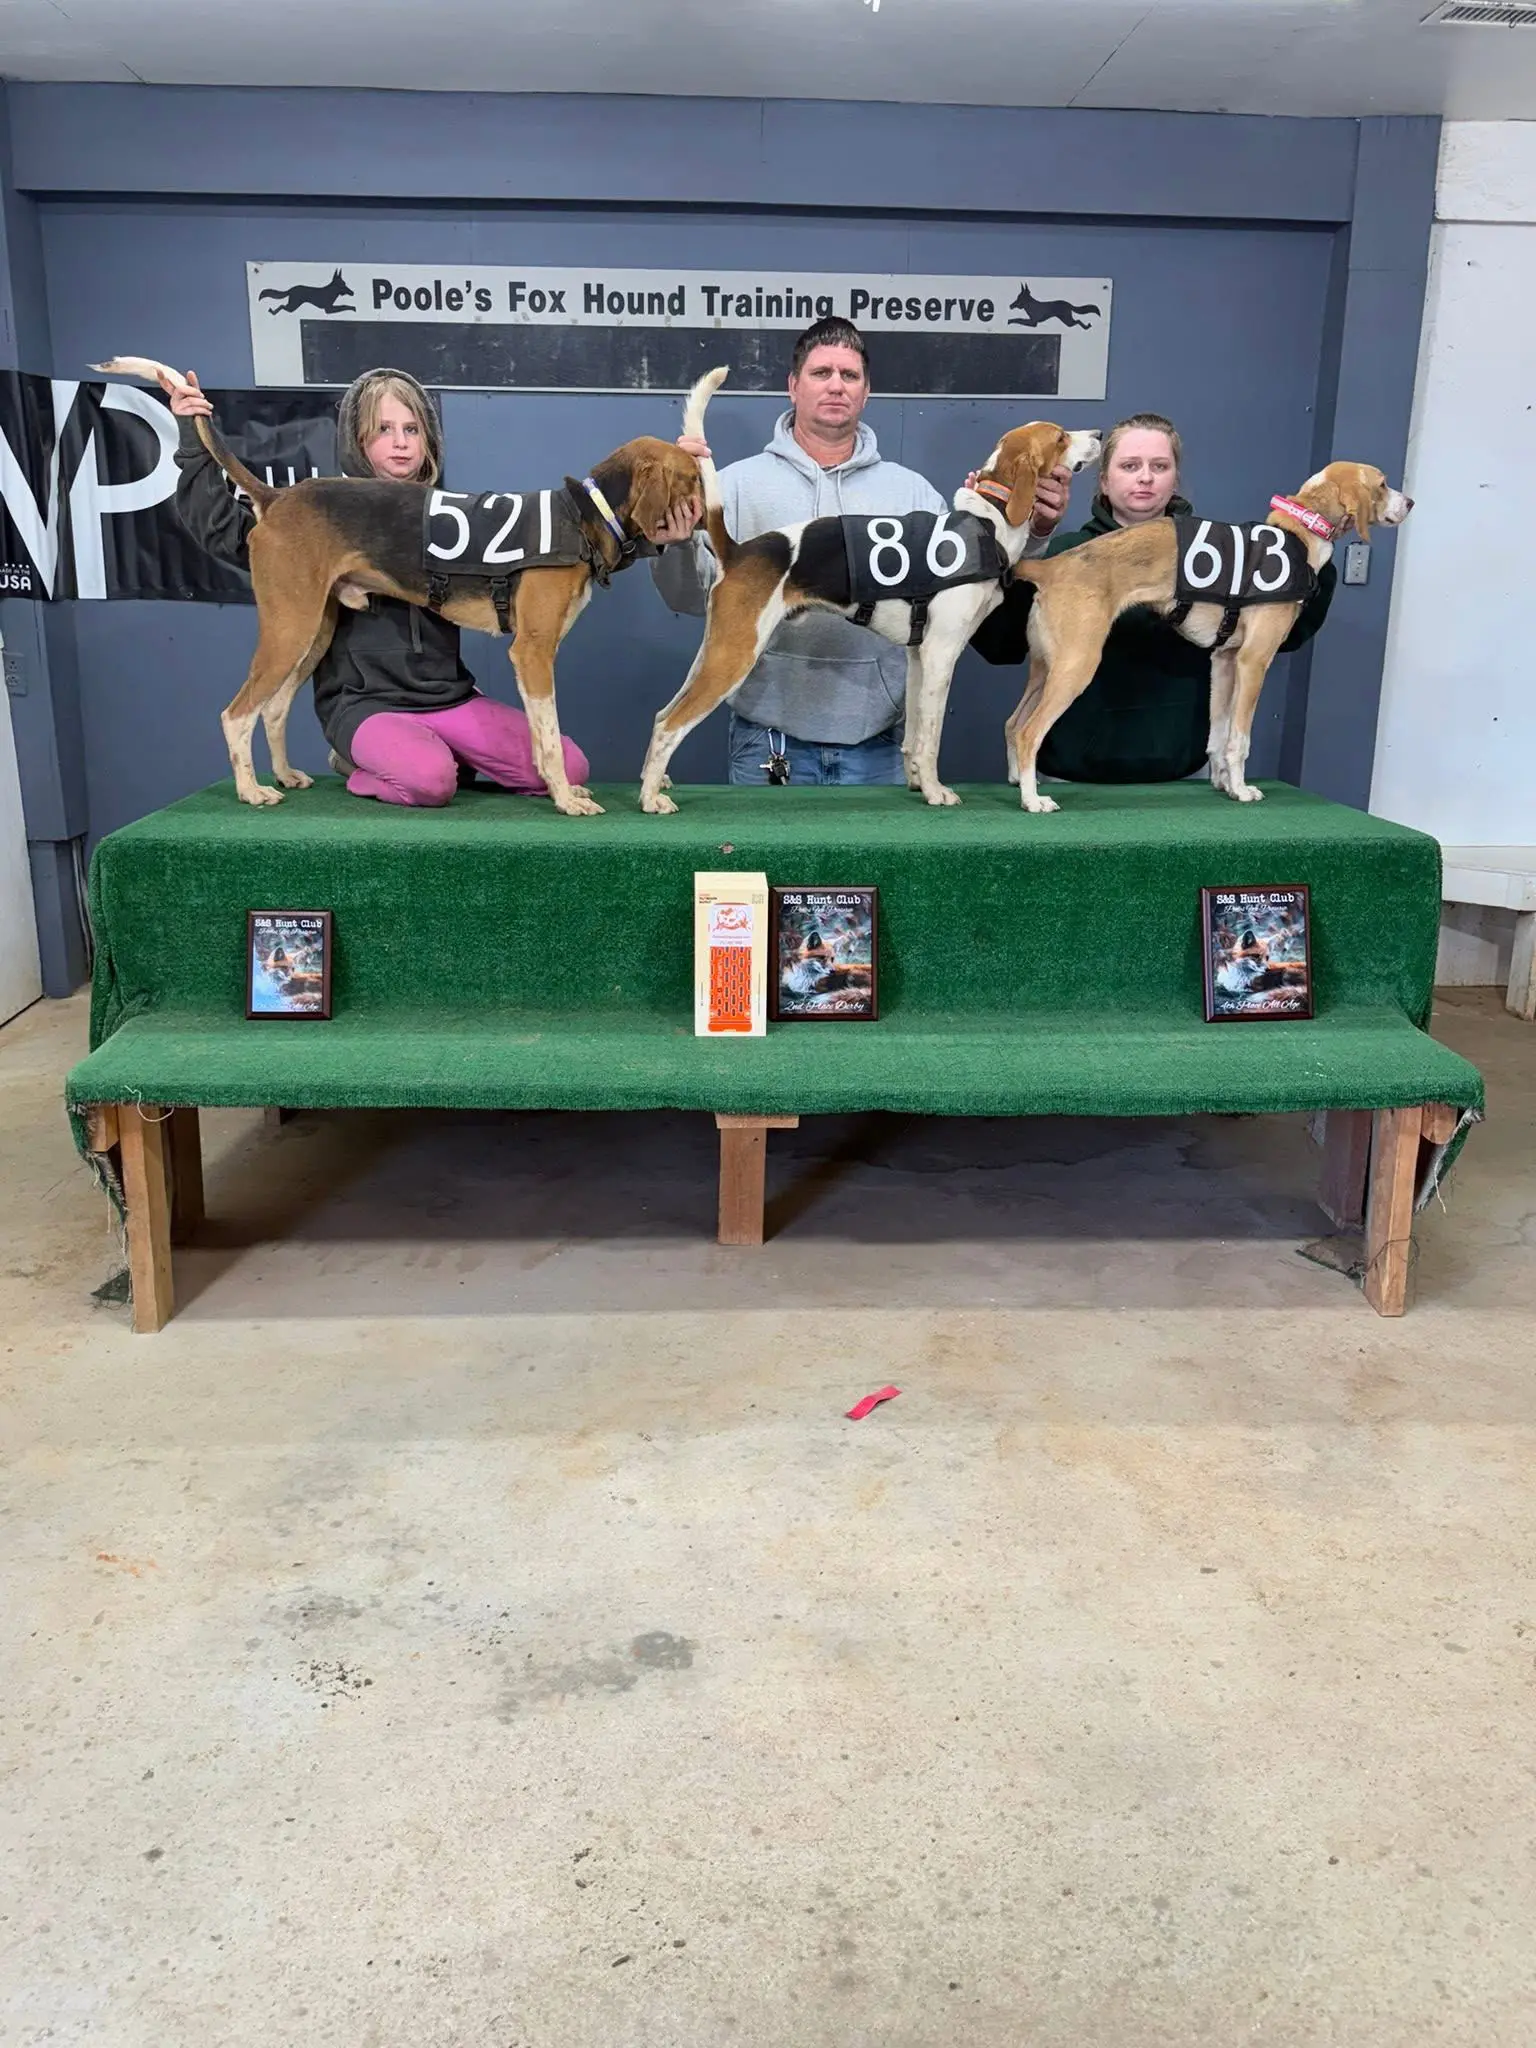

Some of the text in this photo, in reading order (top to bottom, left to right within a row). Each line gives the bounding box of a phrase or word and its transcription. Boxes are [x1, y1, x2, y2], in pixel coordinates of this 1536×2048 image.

[372, 278, 995, 322] Poole's Fox Hound Training Preserve
[427, 490, 551, 563] 521
[867, 512, 966, 586] 86
[1183, 520, 1291, 595] 613
[0, 575, 31, 590] USA
[783, 895, 861, 904] S&S Hunt Club
[1216, 893, 1295, 904] S&S Hunt Club
[275, 919, 297, 928] Hunt
[301, 919, 322, 928] Club
